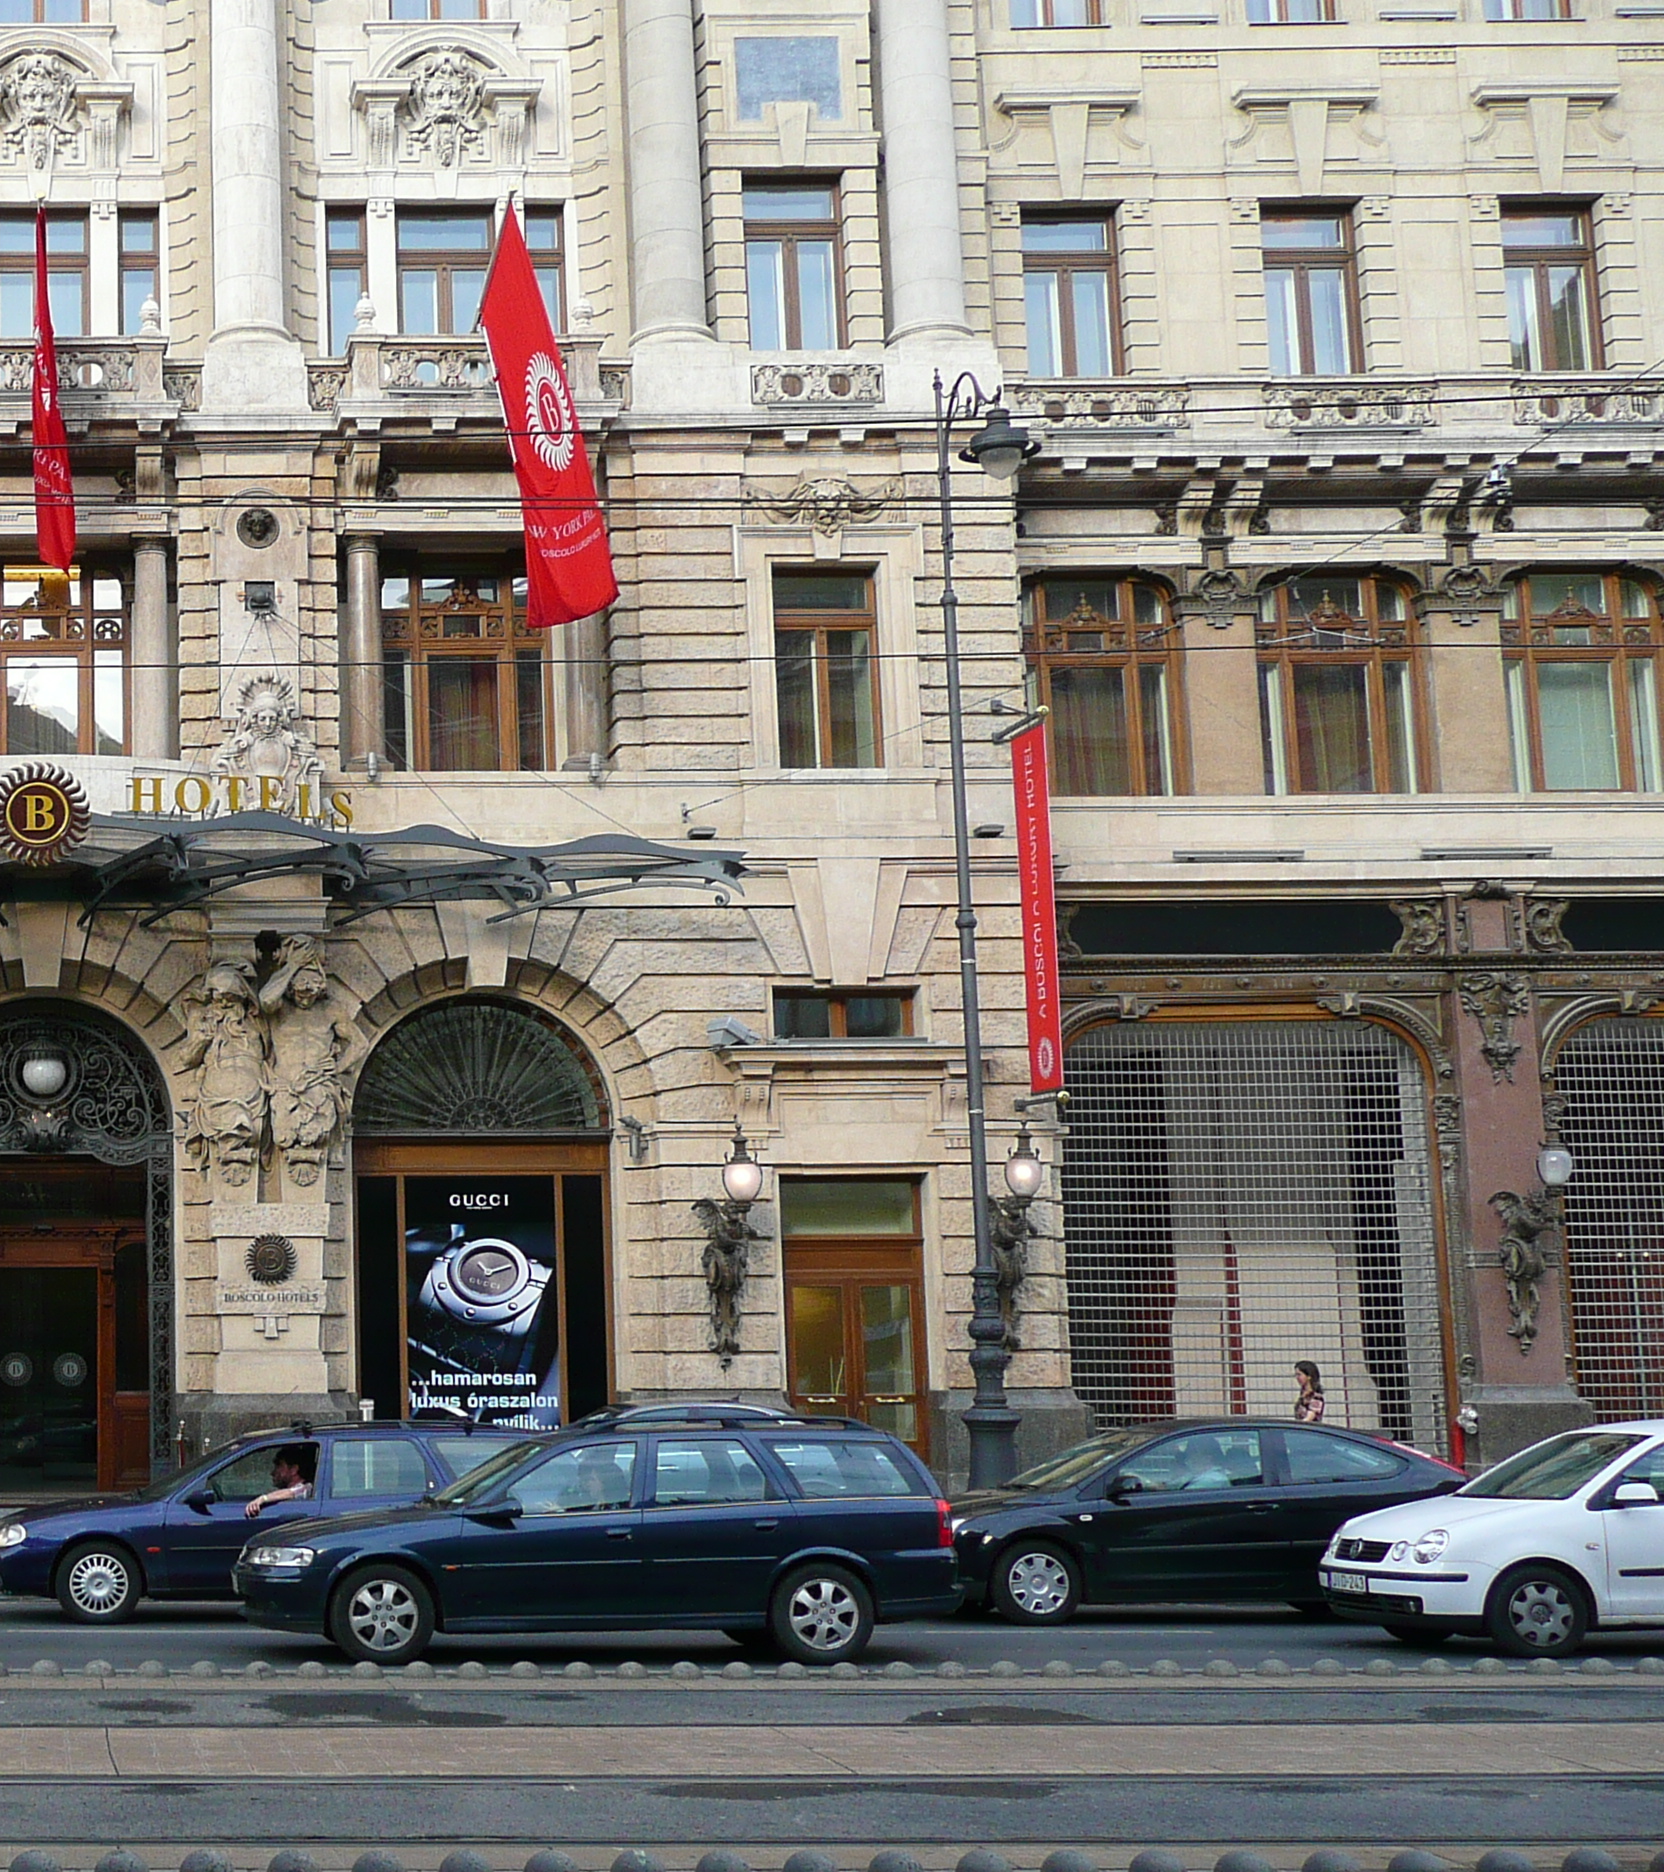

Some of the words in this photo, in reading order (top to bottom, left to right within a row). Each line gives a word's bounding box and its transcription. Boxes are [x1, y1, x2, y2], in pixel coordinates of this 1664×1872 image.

[541, 393, 559, 432] B
[552, 515, 583, 540] YORK
[1024, 741, 1035, 809] HOTEL
[127, 775, 354, 827] HOTELS
[22, 795, 55, 830] B
[449, 1194, 509, 1207] GUCCI
[469, 1277, 501, 1290] GUCCI
[224, 1292, 275, 1303] BOSCOLO
[277, 1292, 319, 1303] HOTELS
[411, 1370, 537, 1386] ...hamarosan
[411, 1392, 461, 1408] luxus
[467, 1392, 559, 1408] óraszalon
